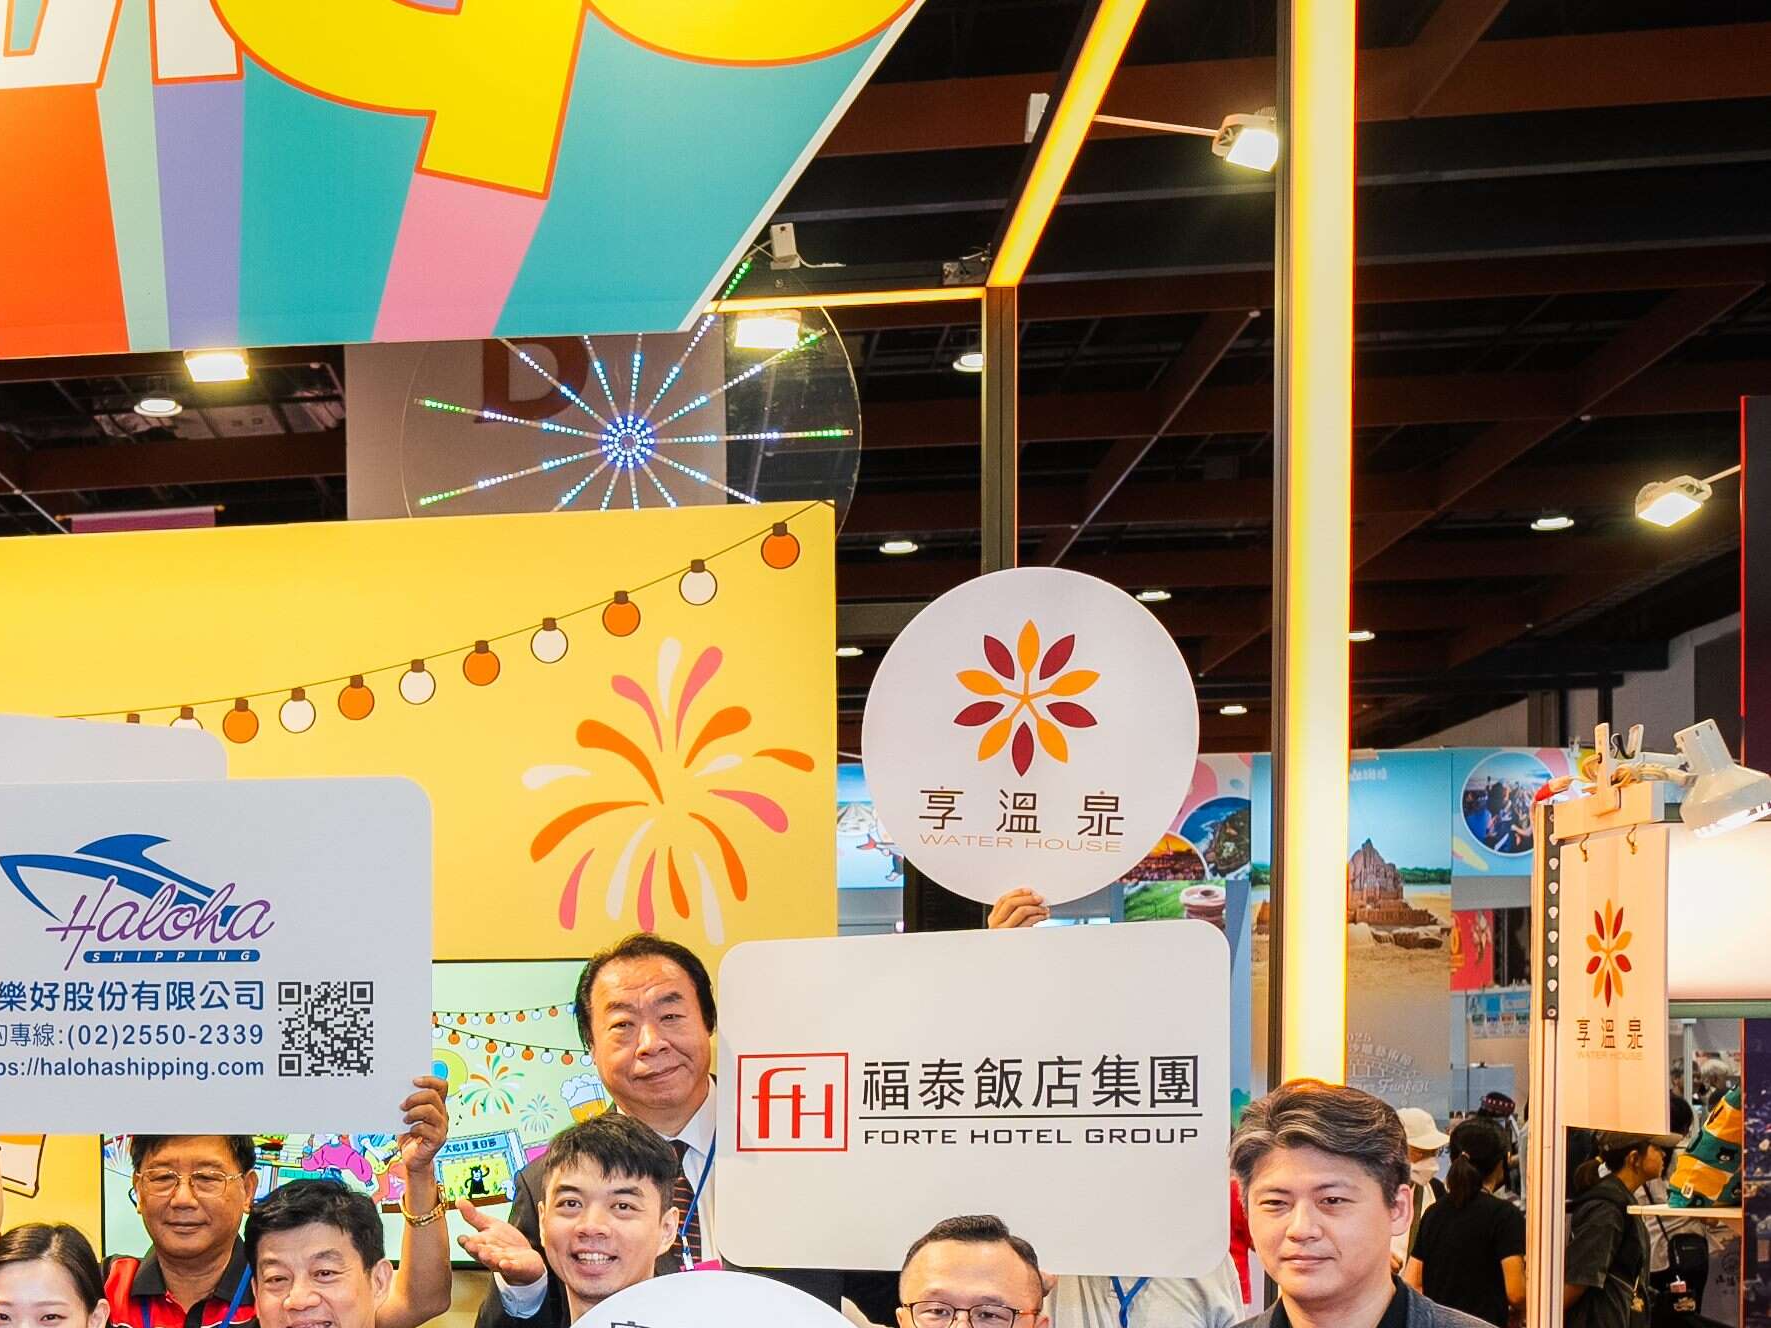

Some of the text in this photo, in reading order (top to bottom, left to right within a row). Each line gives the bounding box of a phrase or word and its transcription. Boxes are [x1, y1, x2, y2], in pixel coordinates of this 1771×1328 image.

[919, 785, 1126, 837] 享溫泉
[919, 834, 1122, 853] WATER HOUSE
[45, 876, 276, 972] Haloha
[91, 950, 251, 963] SHIPPING
[863, 1053, 1200, 1111] 福泰飯店集團
[865, 1128, 1199, 1145] FORTE HOTEL GROUP
